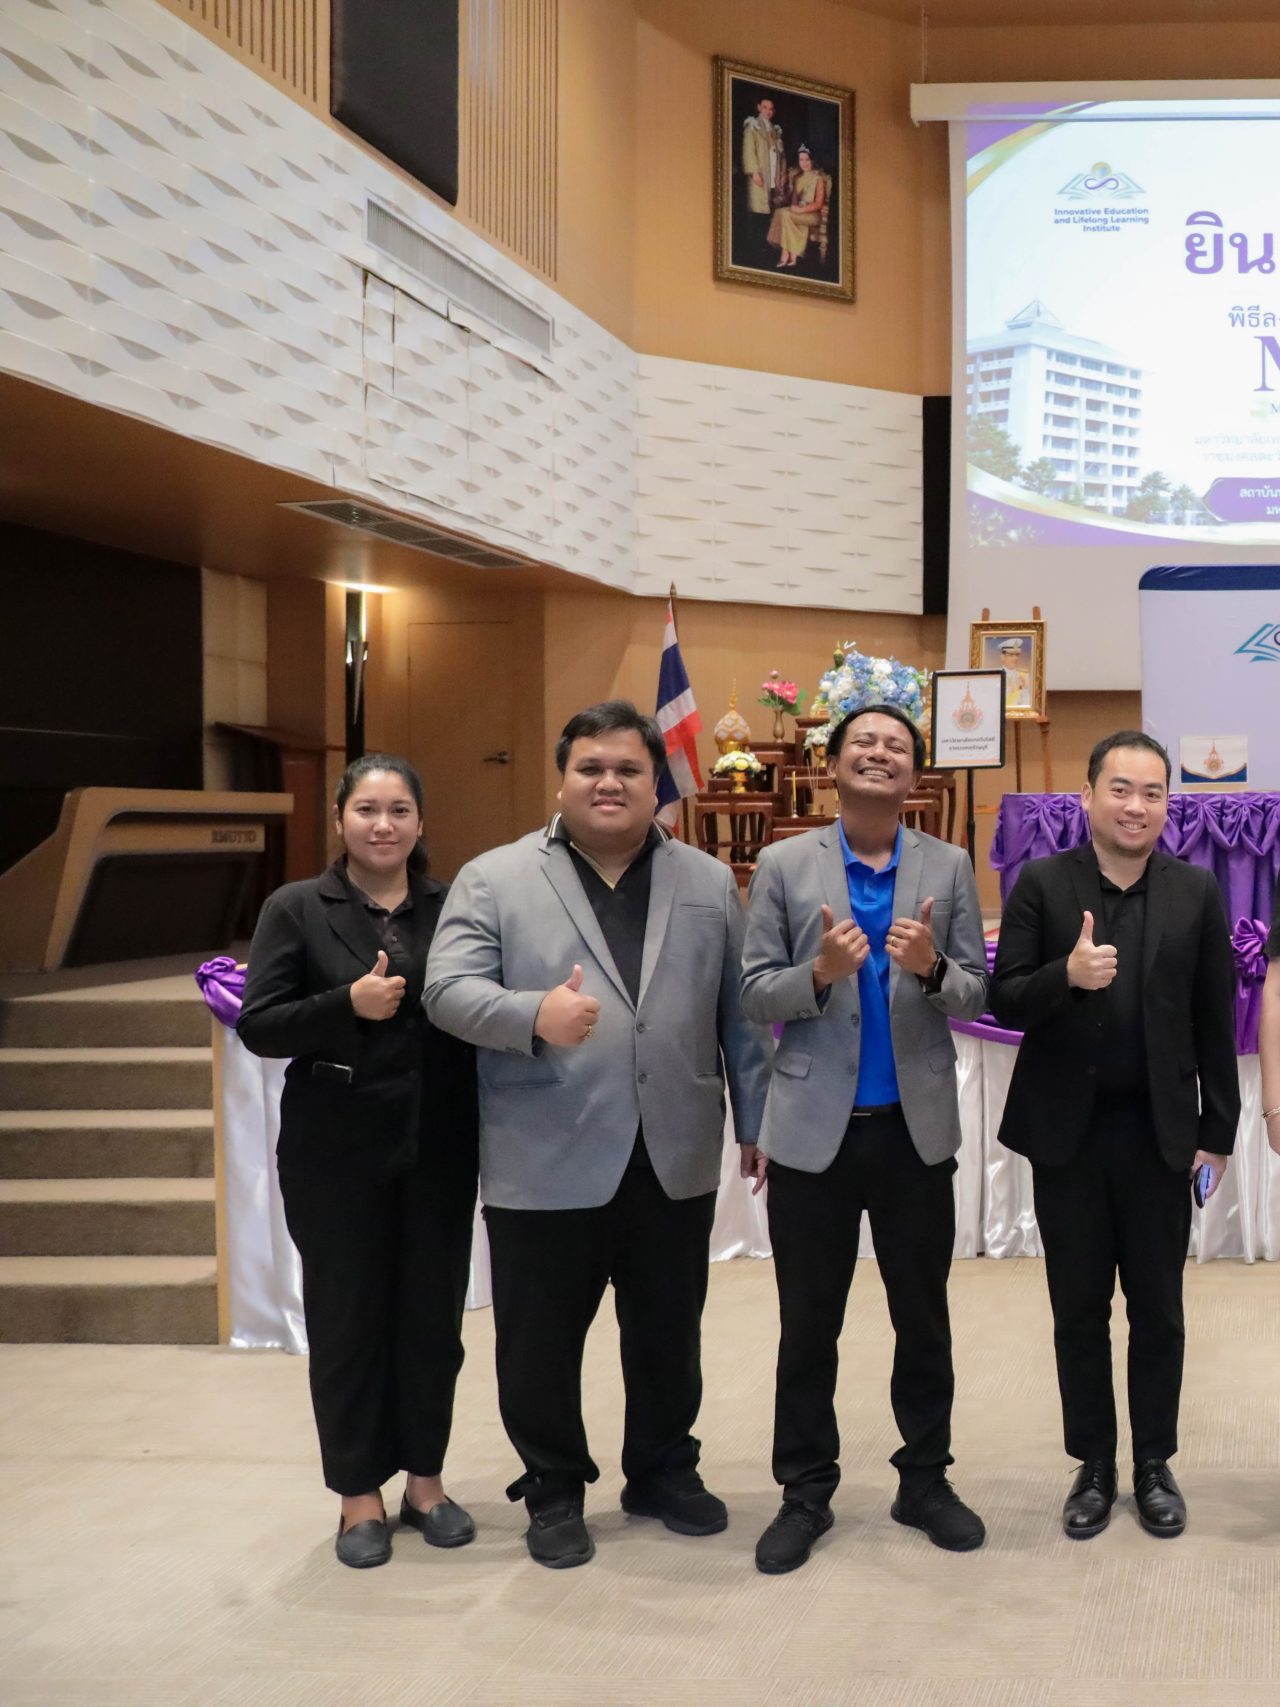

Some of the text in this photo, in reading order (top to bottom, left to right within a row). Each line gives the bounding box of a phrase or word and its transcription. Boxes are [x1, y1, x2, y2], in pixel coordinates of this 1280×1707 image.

[1054, 207, 1149, 216] Innovative Education
[1054, 216, 1150, 225] and Lifelong Learning
